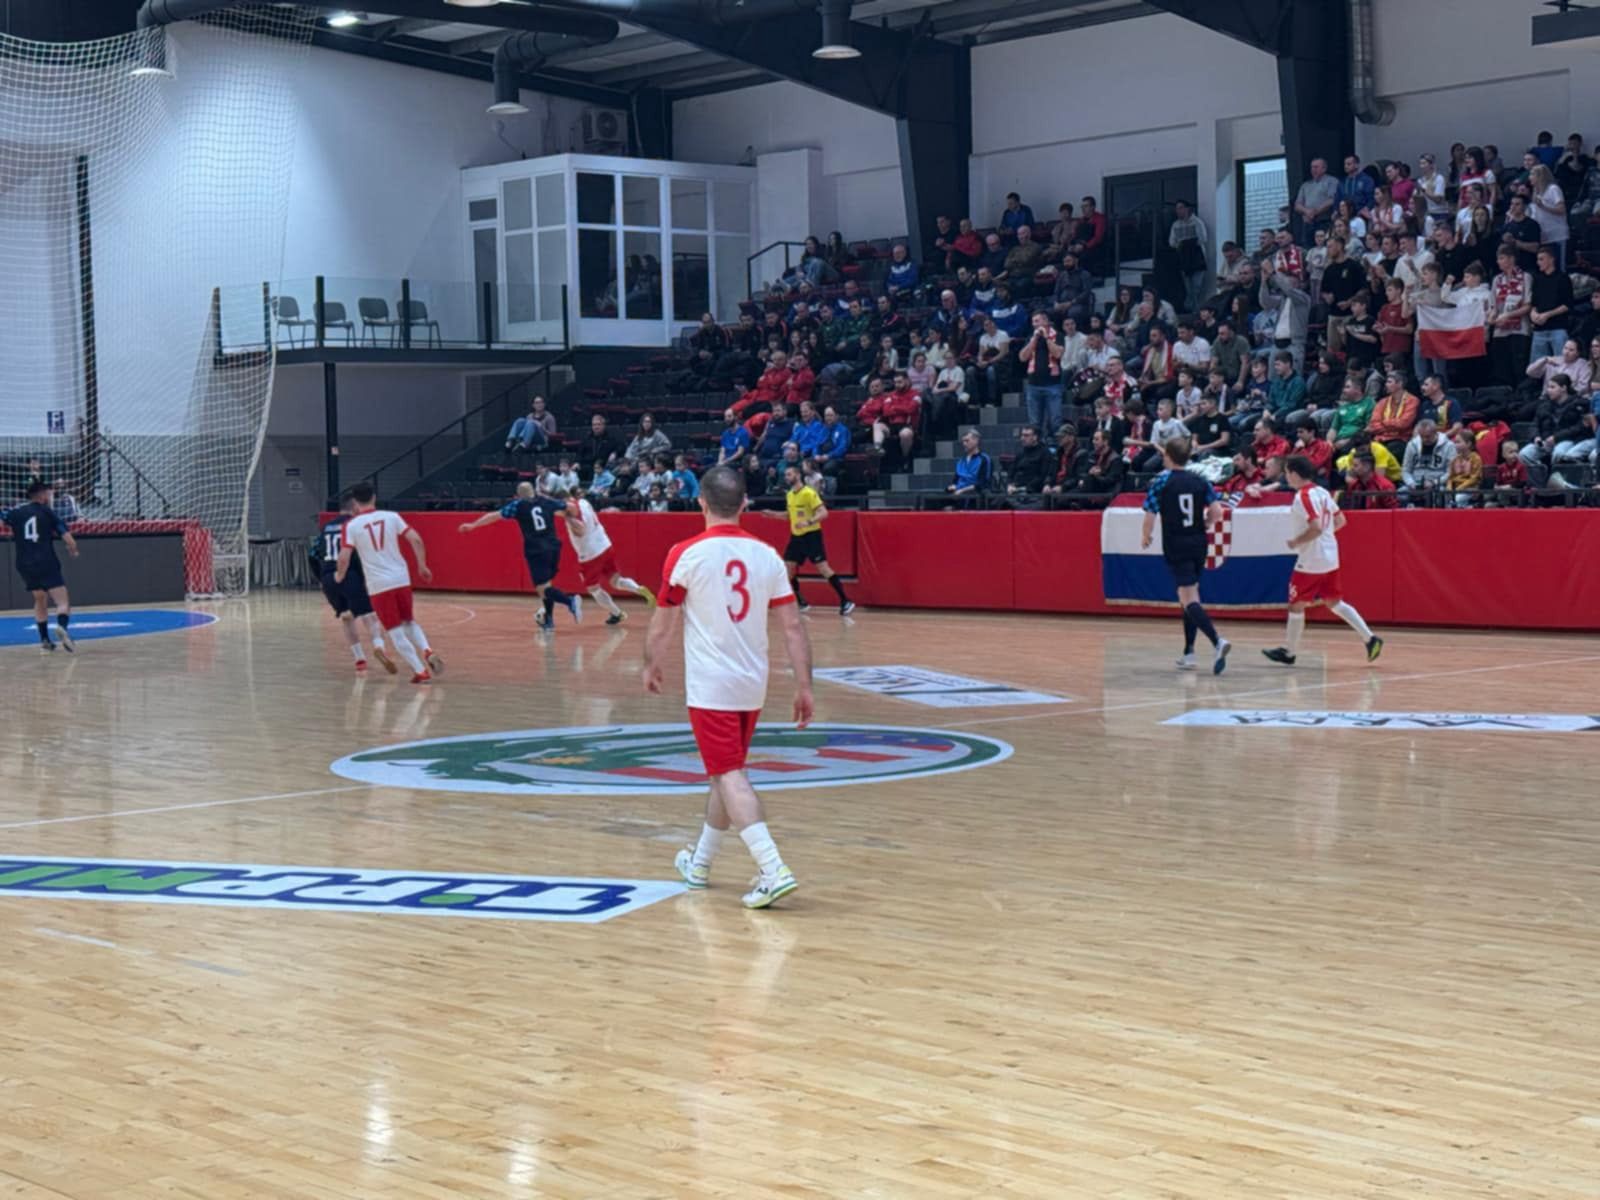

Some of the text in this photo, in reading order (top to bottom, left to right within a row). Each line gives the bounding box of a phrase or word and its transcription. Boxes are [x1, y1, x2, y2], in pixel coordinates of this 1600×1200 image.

[531, 506, 547, 531] 6
[1178, 493, 1194, 527] 9
[24, 516, 39, 543] 4
[363, 519, 385, 552] 17
[725, 559, 750, 624] 3
